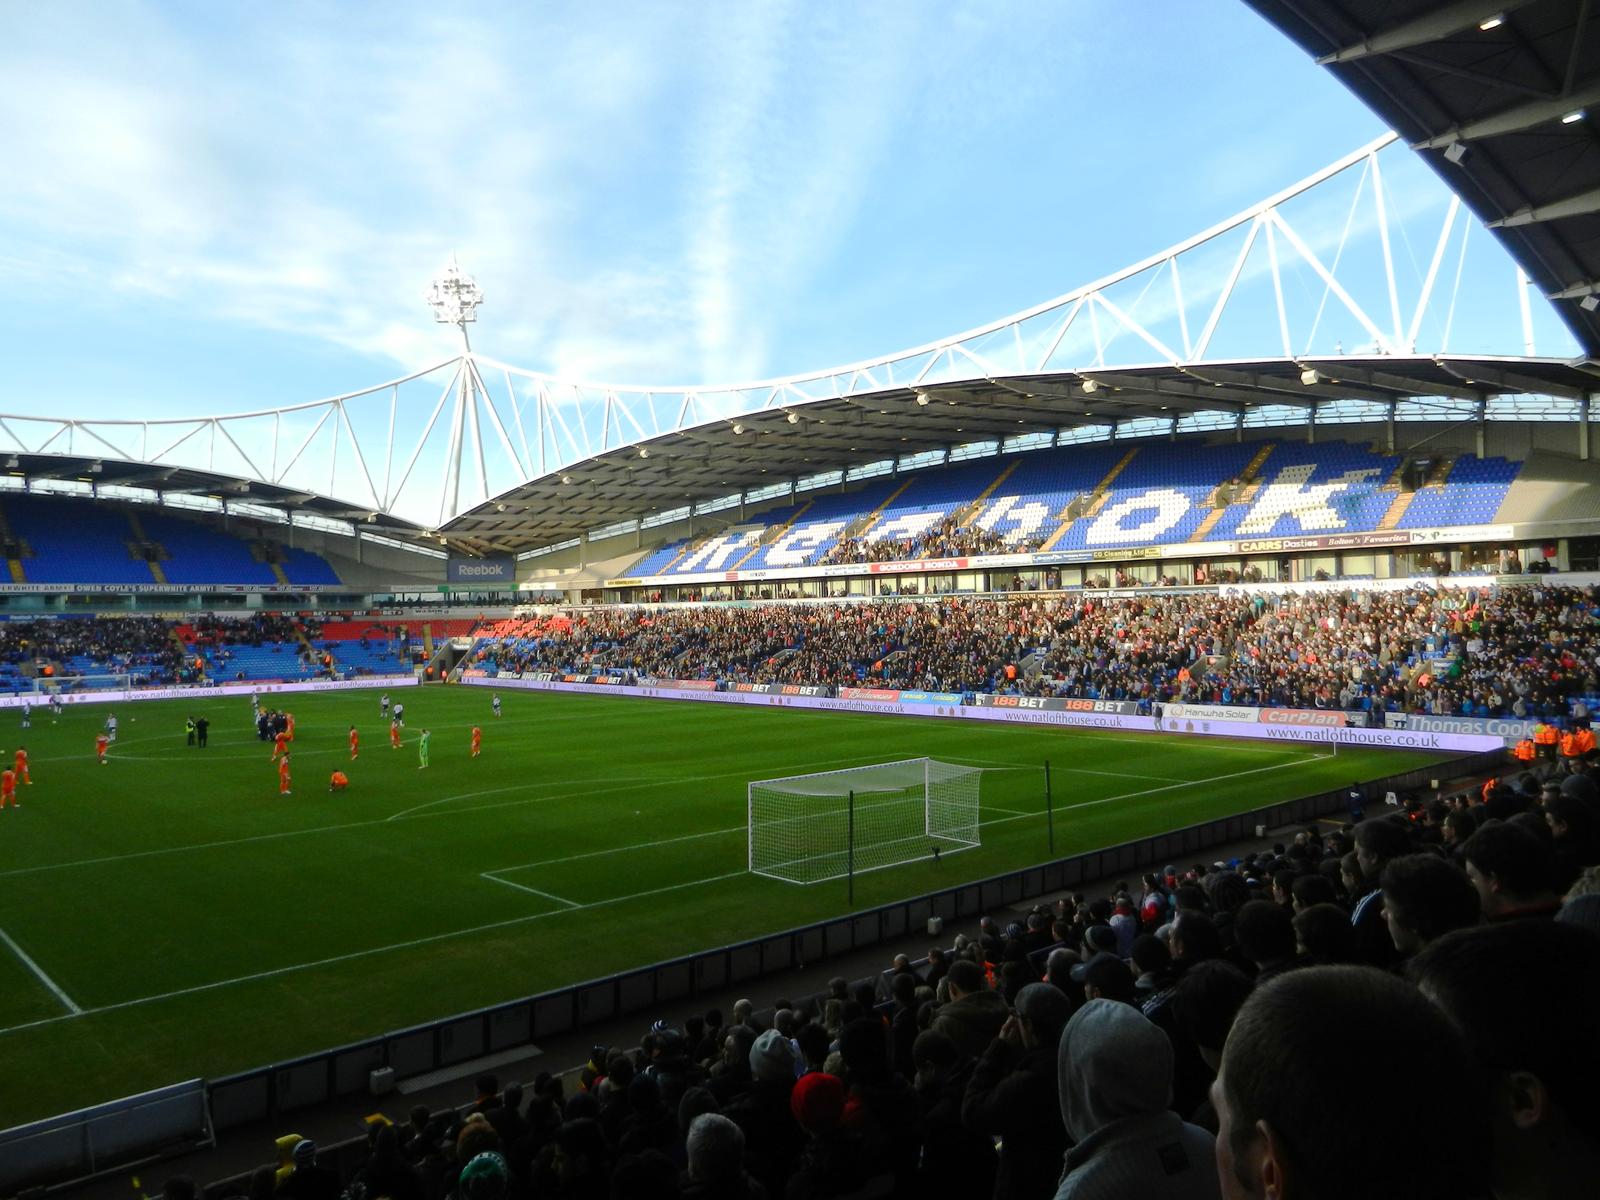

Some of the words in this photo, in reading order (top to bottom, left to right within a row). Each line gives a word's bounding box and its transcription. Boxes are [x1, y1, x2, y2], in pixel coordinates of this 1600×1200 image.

[1241, 541, 1281, 551] CARRS
[1283, 539, 1318, 549] Pasties
[1328, 536, 1361, 546] Bolton's
[1364, 534, 1408, 543] Favourites
[1104, 550, 1132, 558] Cleaning
[1134, 548, 1144, 556] Ltd
[458, 564, 503, 575] Reebok
[879, 562, 922, 571] GORDONS
[924, 560, 958, 569] HONDA
[736, 683, 770, 692] 188BET
[781, 687, 818, 695] 188BET
[849, 689, 893, 700] Budweiser
[819, 701, 904, 713] www.natlofthouse.co.uk
[992, 696, 1046, 707] 188BET
[1065, 700, 1124, 712] 188BET
[1005, 711, 1122, 726] www.natlofthouse.co.uk
[1185, 709, 1223, 717] Hanwha
[1225, 711, 1250, 719] Solar
[1268, 711, 1338, 724] CarPlan
[1409, 716, 1482, 734] Thomas
[1487, 719, 1534, 736] Cook
[1267, 727, 1439, 747] www.natlofthouse.co.uk
